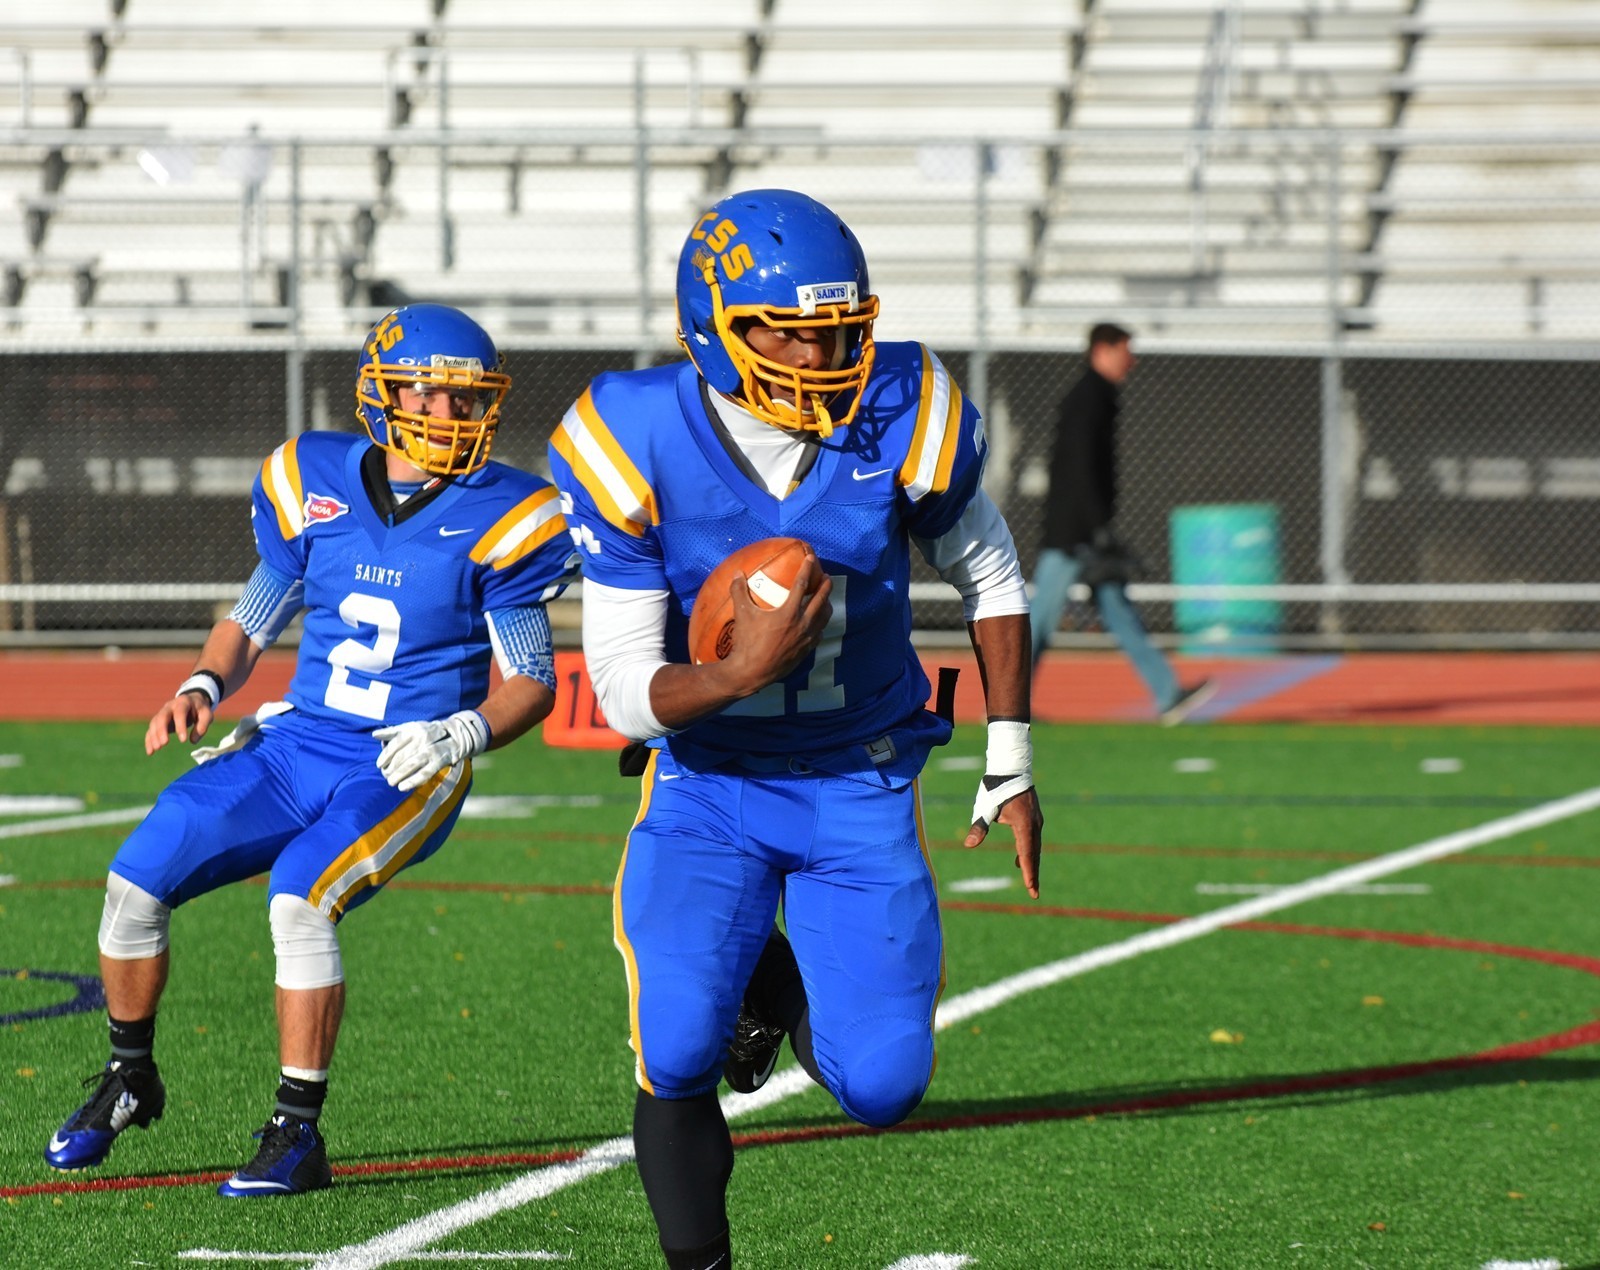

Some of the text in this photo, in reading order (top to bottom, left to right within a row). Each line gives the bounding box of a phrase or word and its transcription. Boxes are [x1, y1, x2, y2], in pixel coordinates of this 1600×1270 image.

[692, 212, 755, 281] CSS
[816, 287, 845, 299] SAINTS
[444, 359, 469, 367] schutt
[310, 503, 332, 517] NCAA
[355, 563, 403, 588] SAINTS
[324, 592, 401, 721] 2
